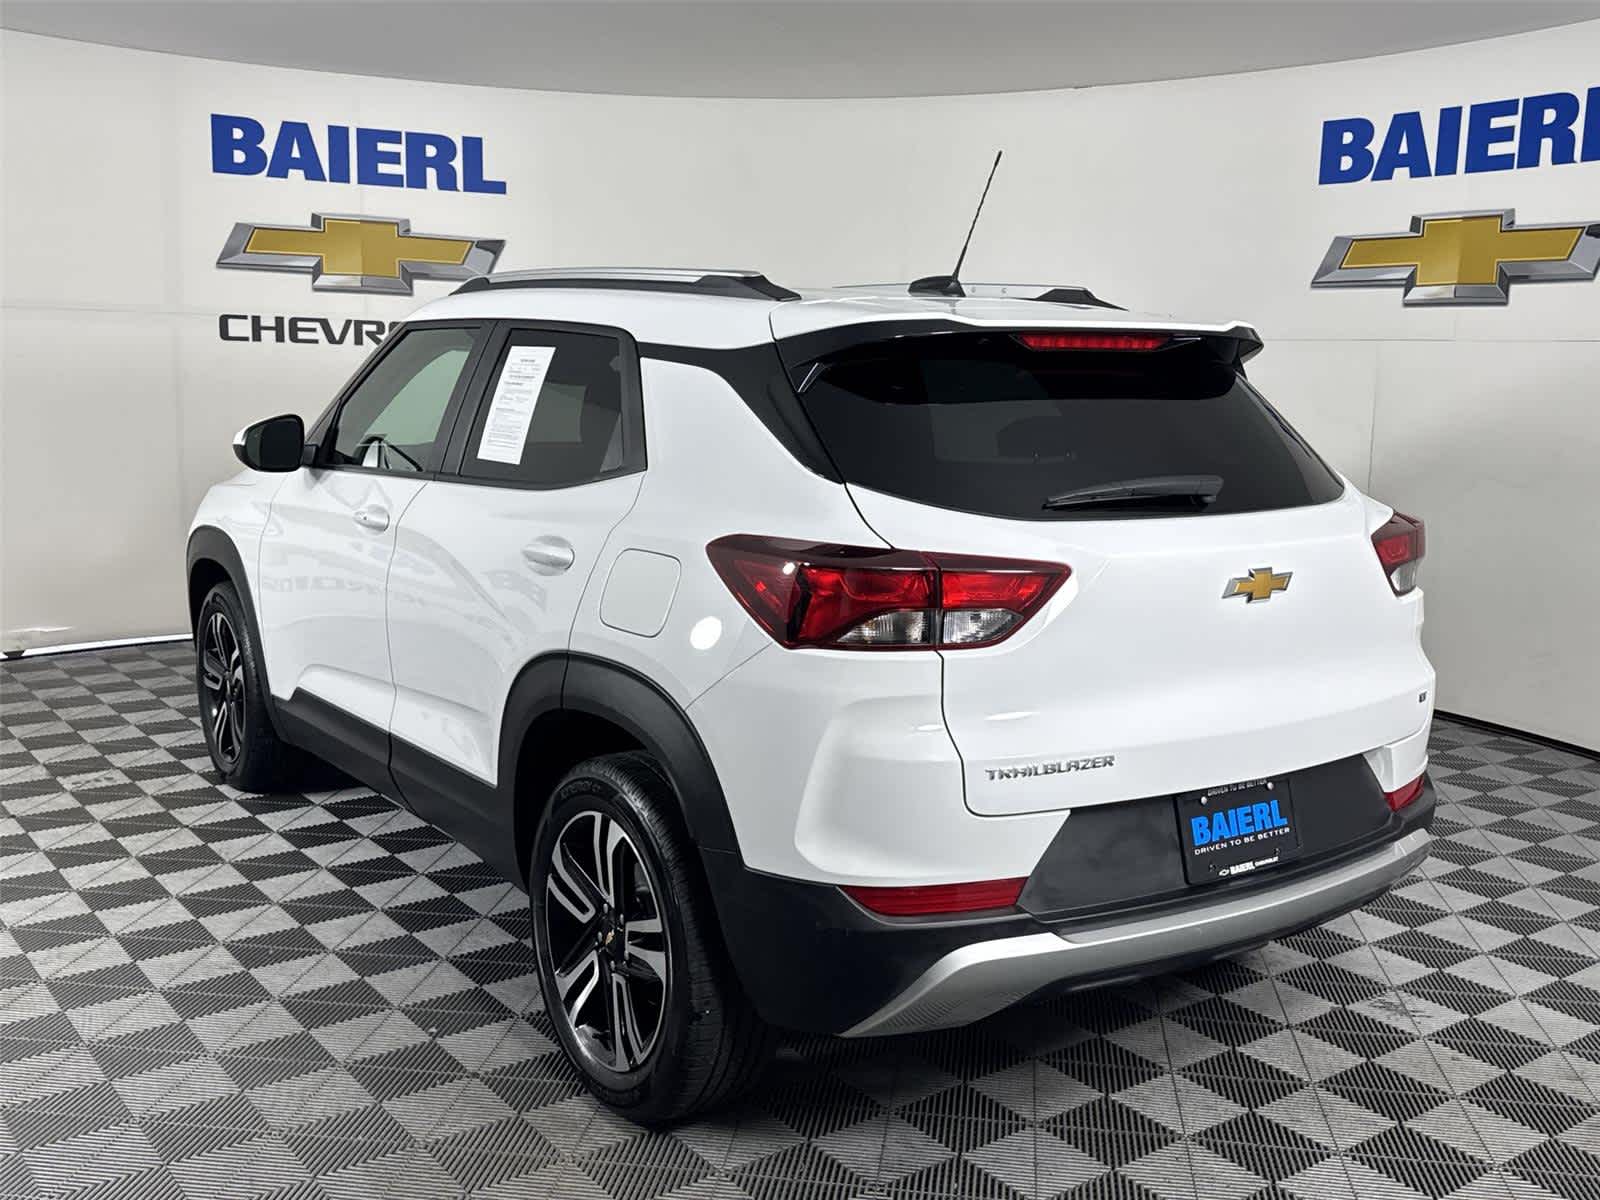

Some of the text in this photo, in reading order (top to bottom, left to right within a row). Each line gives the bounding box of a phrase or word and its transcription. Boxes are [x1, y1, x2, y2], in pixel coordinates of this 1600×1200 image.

[210, 113, 507, 195] BAIERL
[985, 755, 1116, 781] TRAILBLAZER
[1191, 799, 1288, 846] BAIERL
[1194, 827, 1290, 856] DRIVEN TO BE BETTER
